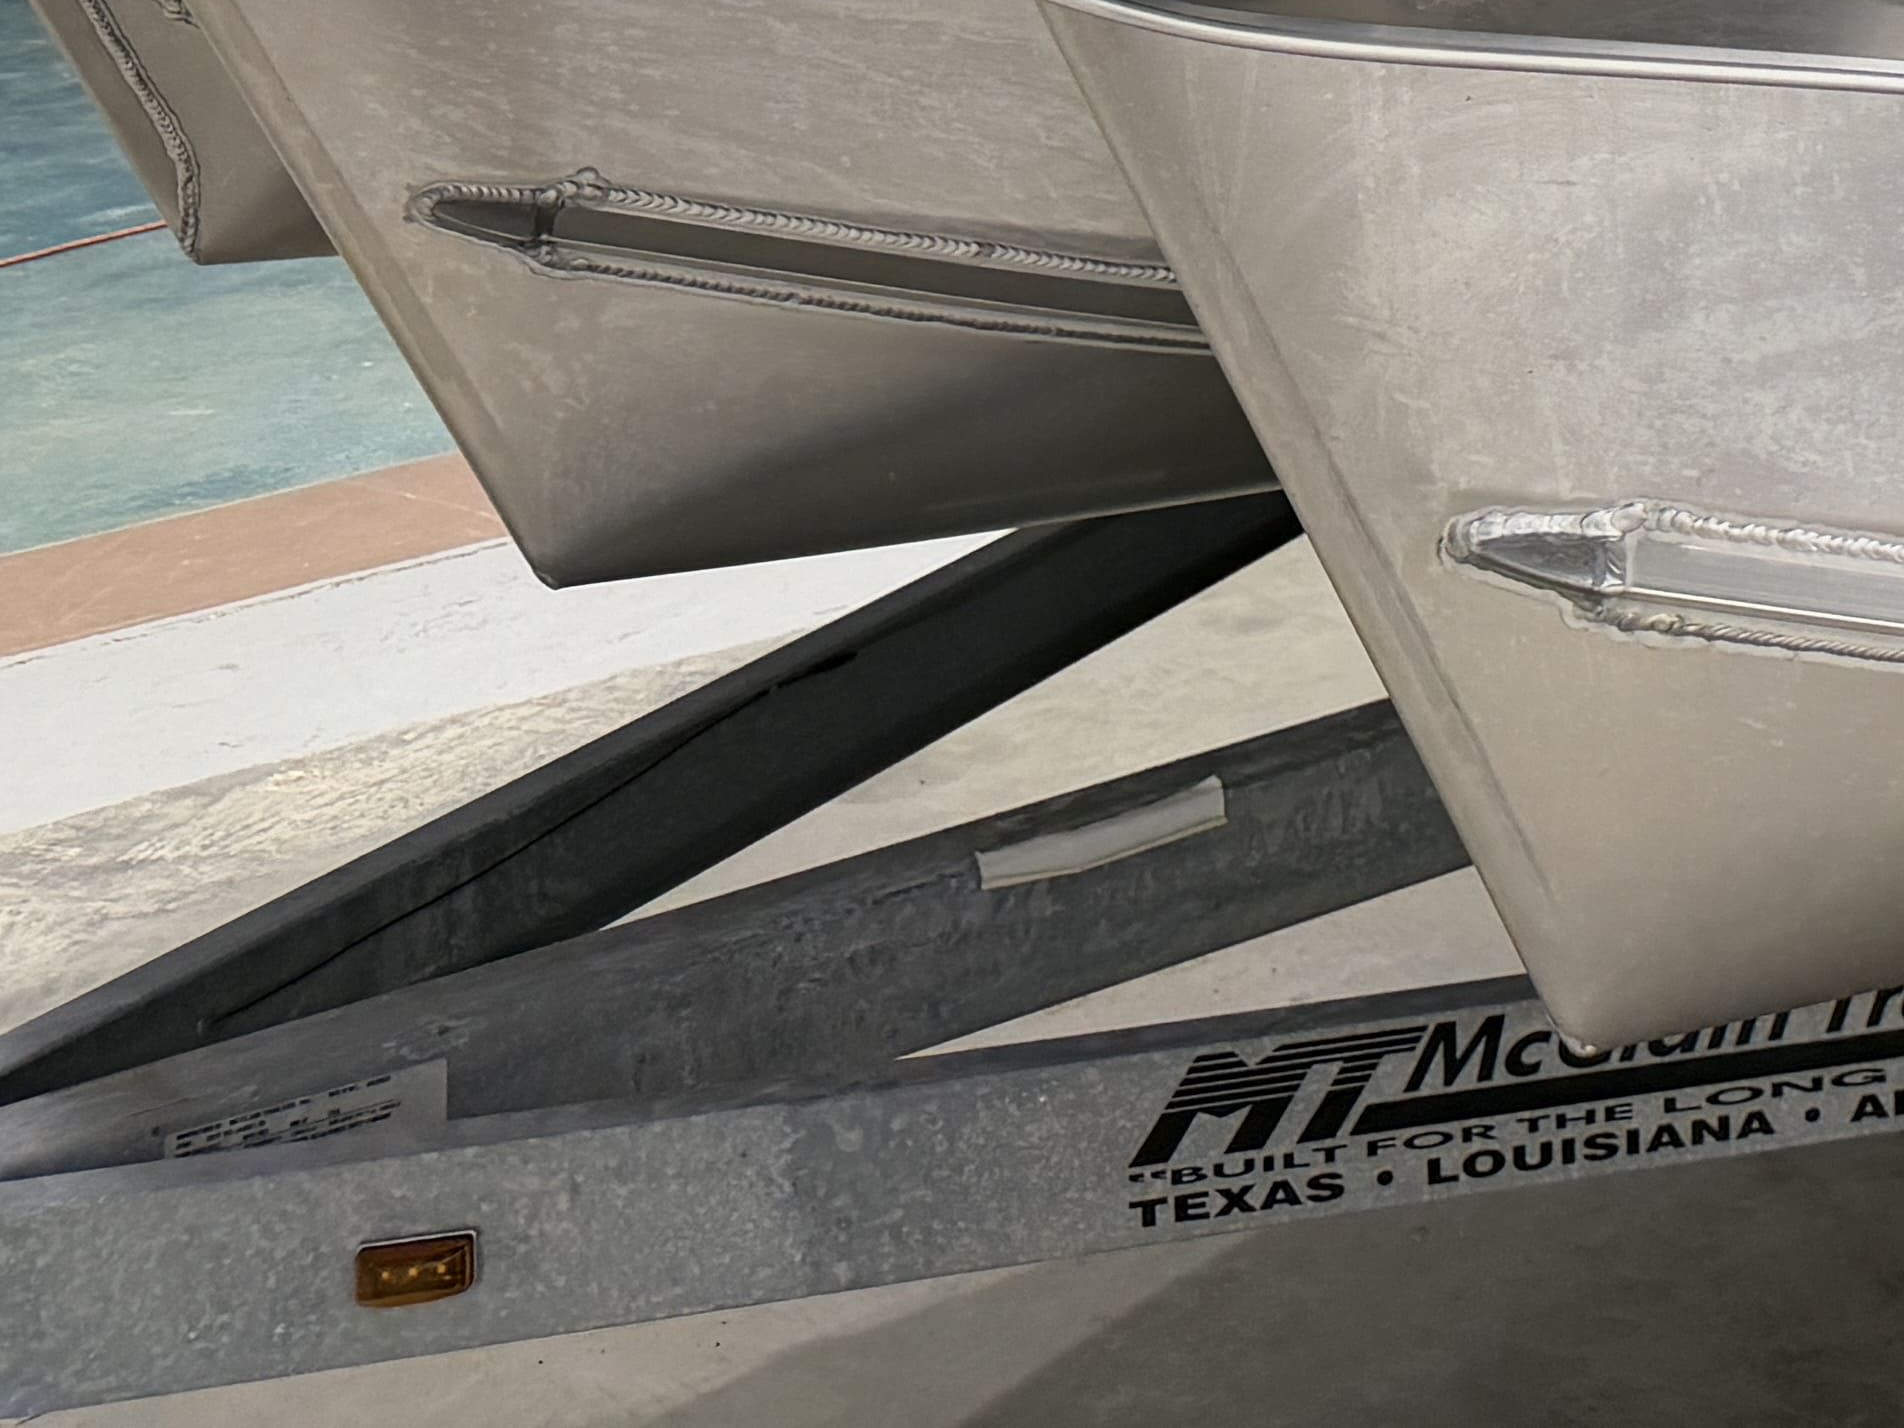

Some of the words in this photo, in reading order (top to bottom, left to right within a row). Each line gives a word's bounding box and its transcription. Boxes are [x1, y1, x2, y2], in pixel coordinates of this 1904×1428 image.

[1128, 1144, 1348, 1186] “BUILT
[1366, 1123, 1497, 1157] FOR
[1516, 1102, 1634, 1134] THE
[1663, 1067, 1887, 1113] LONG
[1128, 1172, 1345, 1228] TEXAS
[1427, 1109, 1774, 1185] LOUISIANA
